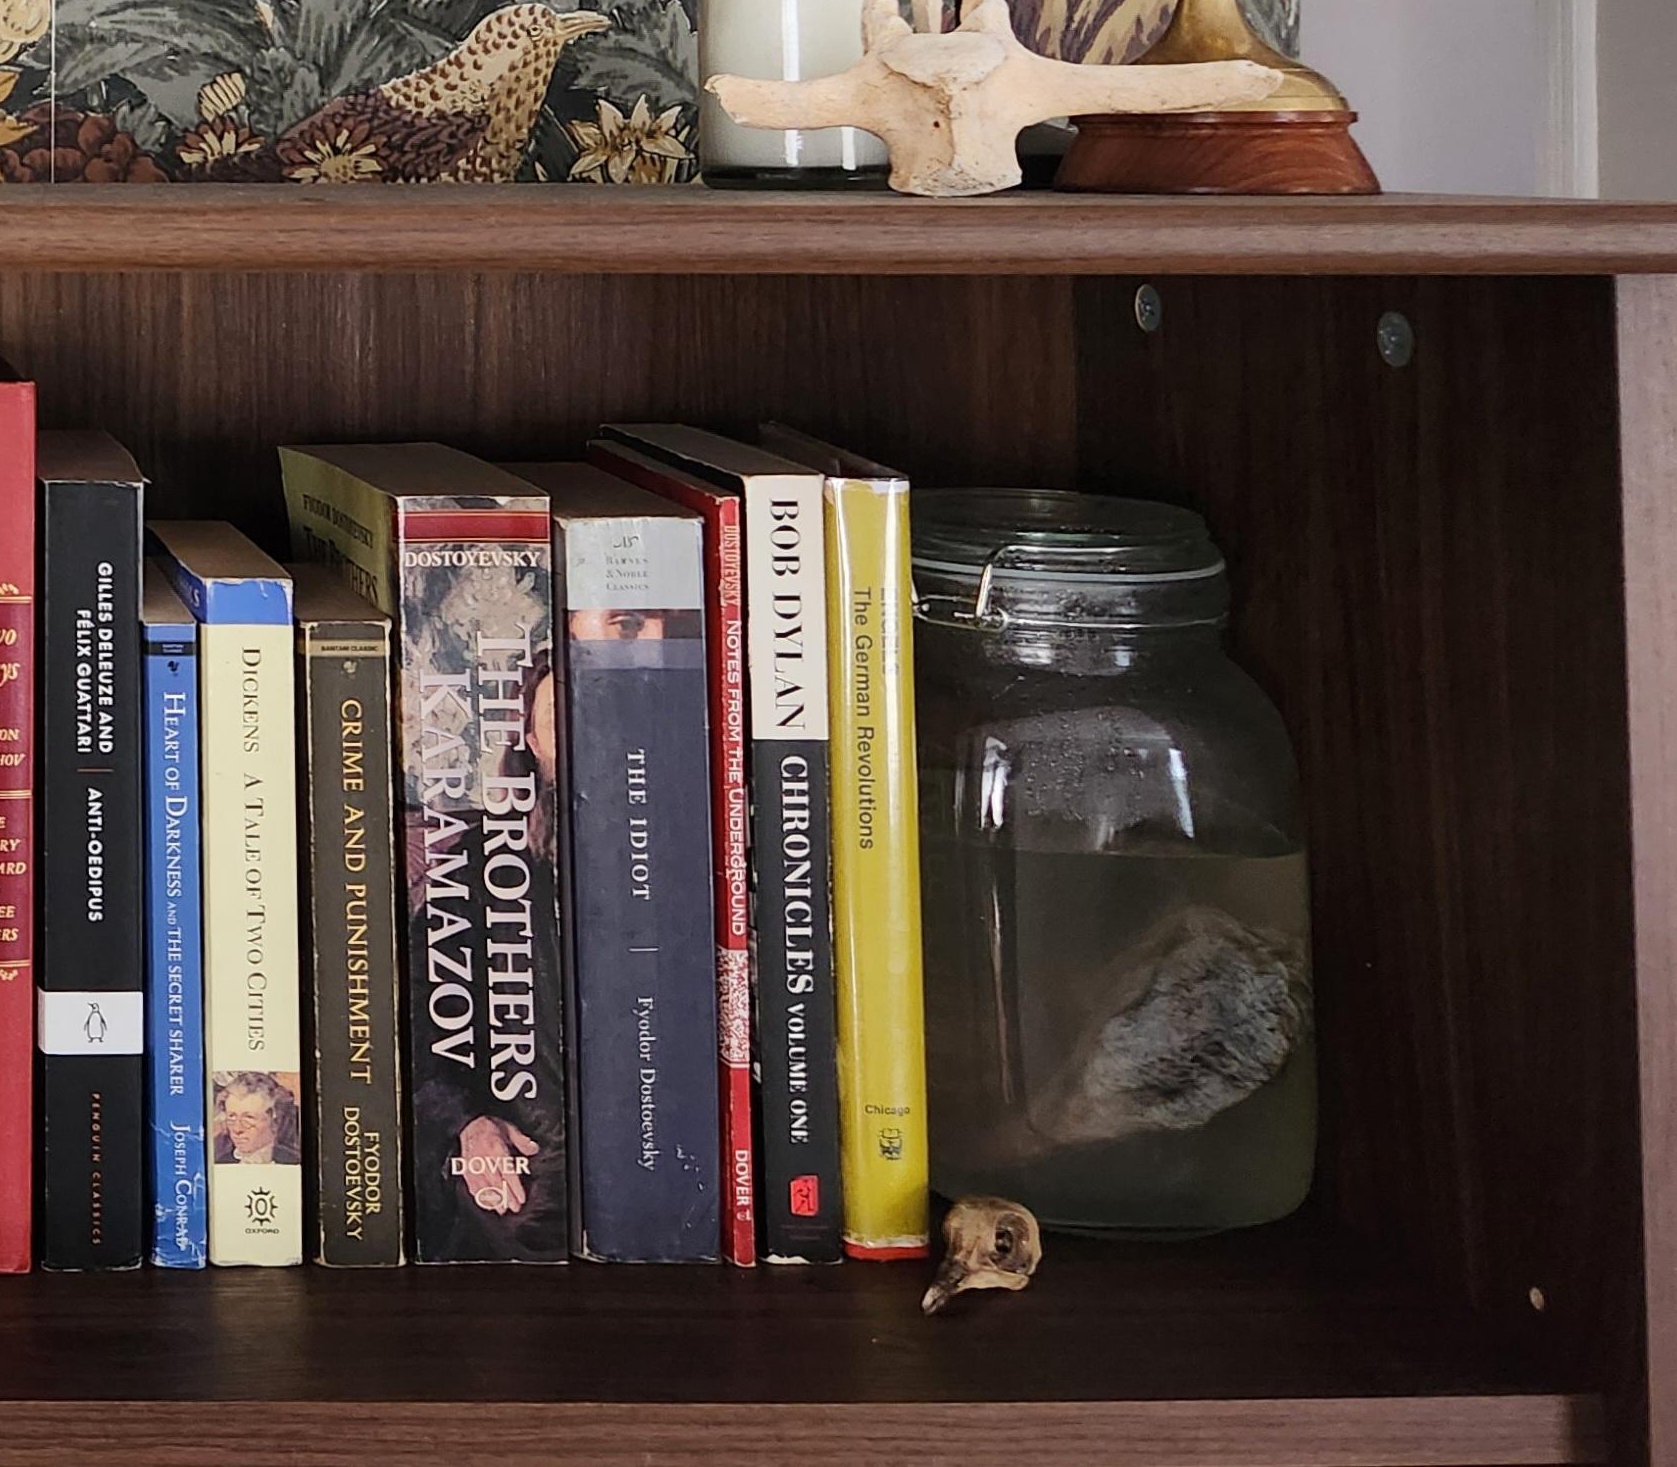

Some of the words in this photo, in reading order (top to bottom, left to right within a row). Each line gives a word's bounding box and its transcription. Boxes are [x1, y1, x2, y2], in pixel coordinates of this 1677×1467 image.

[404, 550, 541, 568] DOSTOYEVSKY
[769, 498, 802, 578] BOB
[97, 562, 114, 623] GILLES
[605, 583, 650, 591] CLASSICS
[616, 570, 649, 579] NOBLE
[853, 587, 872, 626] The
[97, 627, 114, 706] DELEUZE
[726, 619, 742, 683] NOTES
[771, 592, 806, 731] DYLAN
[854, 634, 874, 717] German
[76, 662, 92, 753] GUATTARI
[476, 623, 533, 754] THE
[727, 685, 742, 742] FROM
[97, 711, 114, 754] AND
[340, 698, 365, 793] CRIME
[728, 747, 744, 786] THE
[627, 748, 647, 804] THE
[855, 726, 878, 850] Revolutions
[87, 787, 104, 923] ANTI-OEDIPUS
[342, 804, 367, 873] AND
[419, 668, 475, 1070] KARAMAZOV
[629, 818, 651, 901] IDIOT
[728, 788, 747, 936] UNDERGROUND
[780, 754, 814, 994] CHRONICLES
[166, 901, 178, 926] AND
[167, 927, 183, 962] THE
[481, 772, 538, 1103] BROTHERS
[167, 965, 184, 1027] SECRET
[344, 883, 373, 1086] PUNISHMENT
[168, 1029, 185, 1097] SHARER
[632, 995, 657, 1061] Fyodor
[785, 1003, 809, 1094] VOLUME
[92, 1092, 101, 1162] PENGUIN
[637, 1068, 660, 1171] Dostoevsky
[787, 1098, 810, 1144] ONE
[863, 1104, 912, 1116] Chicago
[342, 1107, 363, 1242] DOSTOEVSKY
[363, 1131, 382, 1215] FYODOR
[450, 1155, 531, 1177] DOVER
[735, 1148, 753, 1206] DOVER
[92, 1171, 101, 1245] CLASSICS
